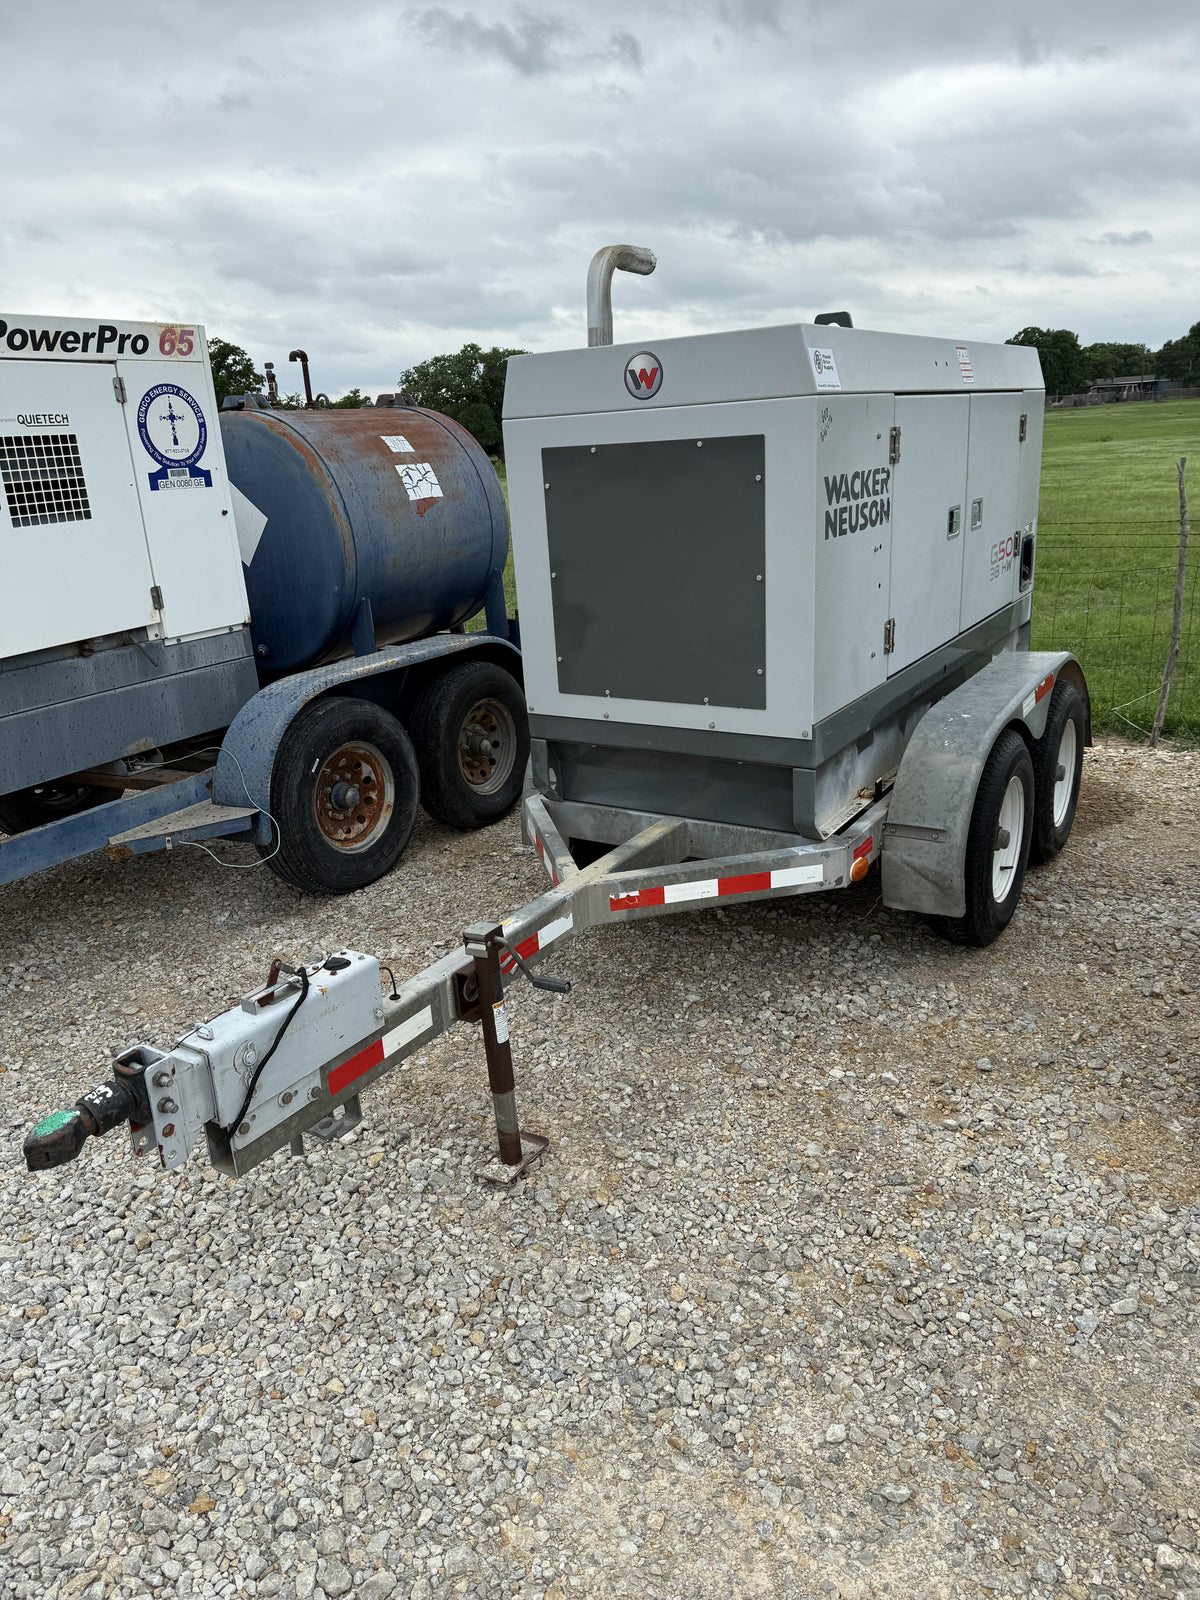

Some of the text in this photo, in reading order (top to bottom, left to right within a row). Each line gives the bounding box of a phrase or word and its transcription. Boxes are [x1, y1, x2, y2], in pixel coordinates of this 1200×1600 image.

[159, 328, 194, 356] 65
[138, 386, 204, 423] GENCO ENERGY SERVICES
[17, 414, 70, 427] QUIETECH
[159, 478, 205, 489] GEN 0080 GE
[824, 467, 890, 506] WACKER
[824, 497, 890, 540] NEUSON
[991, 536, 1014, 566] G50
[989, 564, 1000, 582] 38
